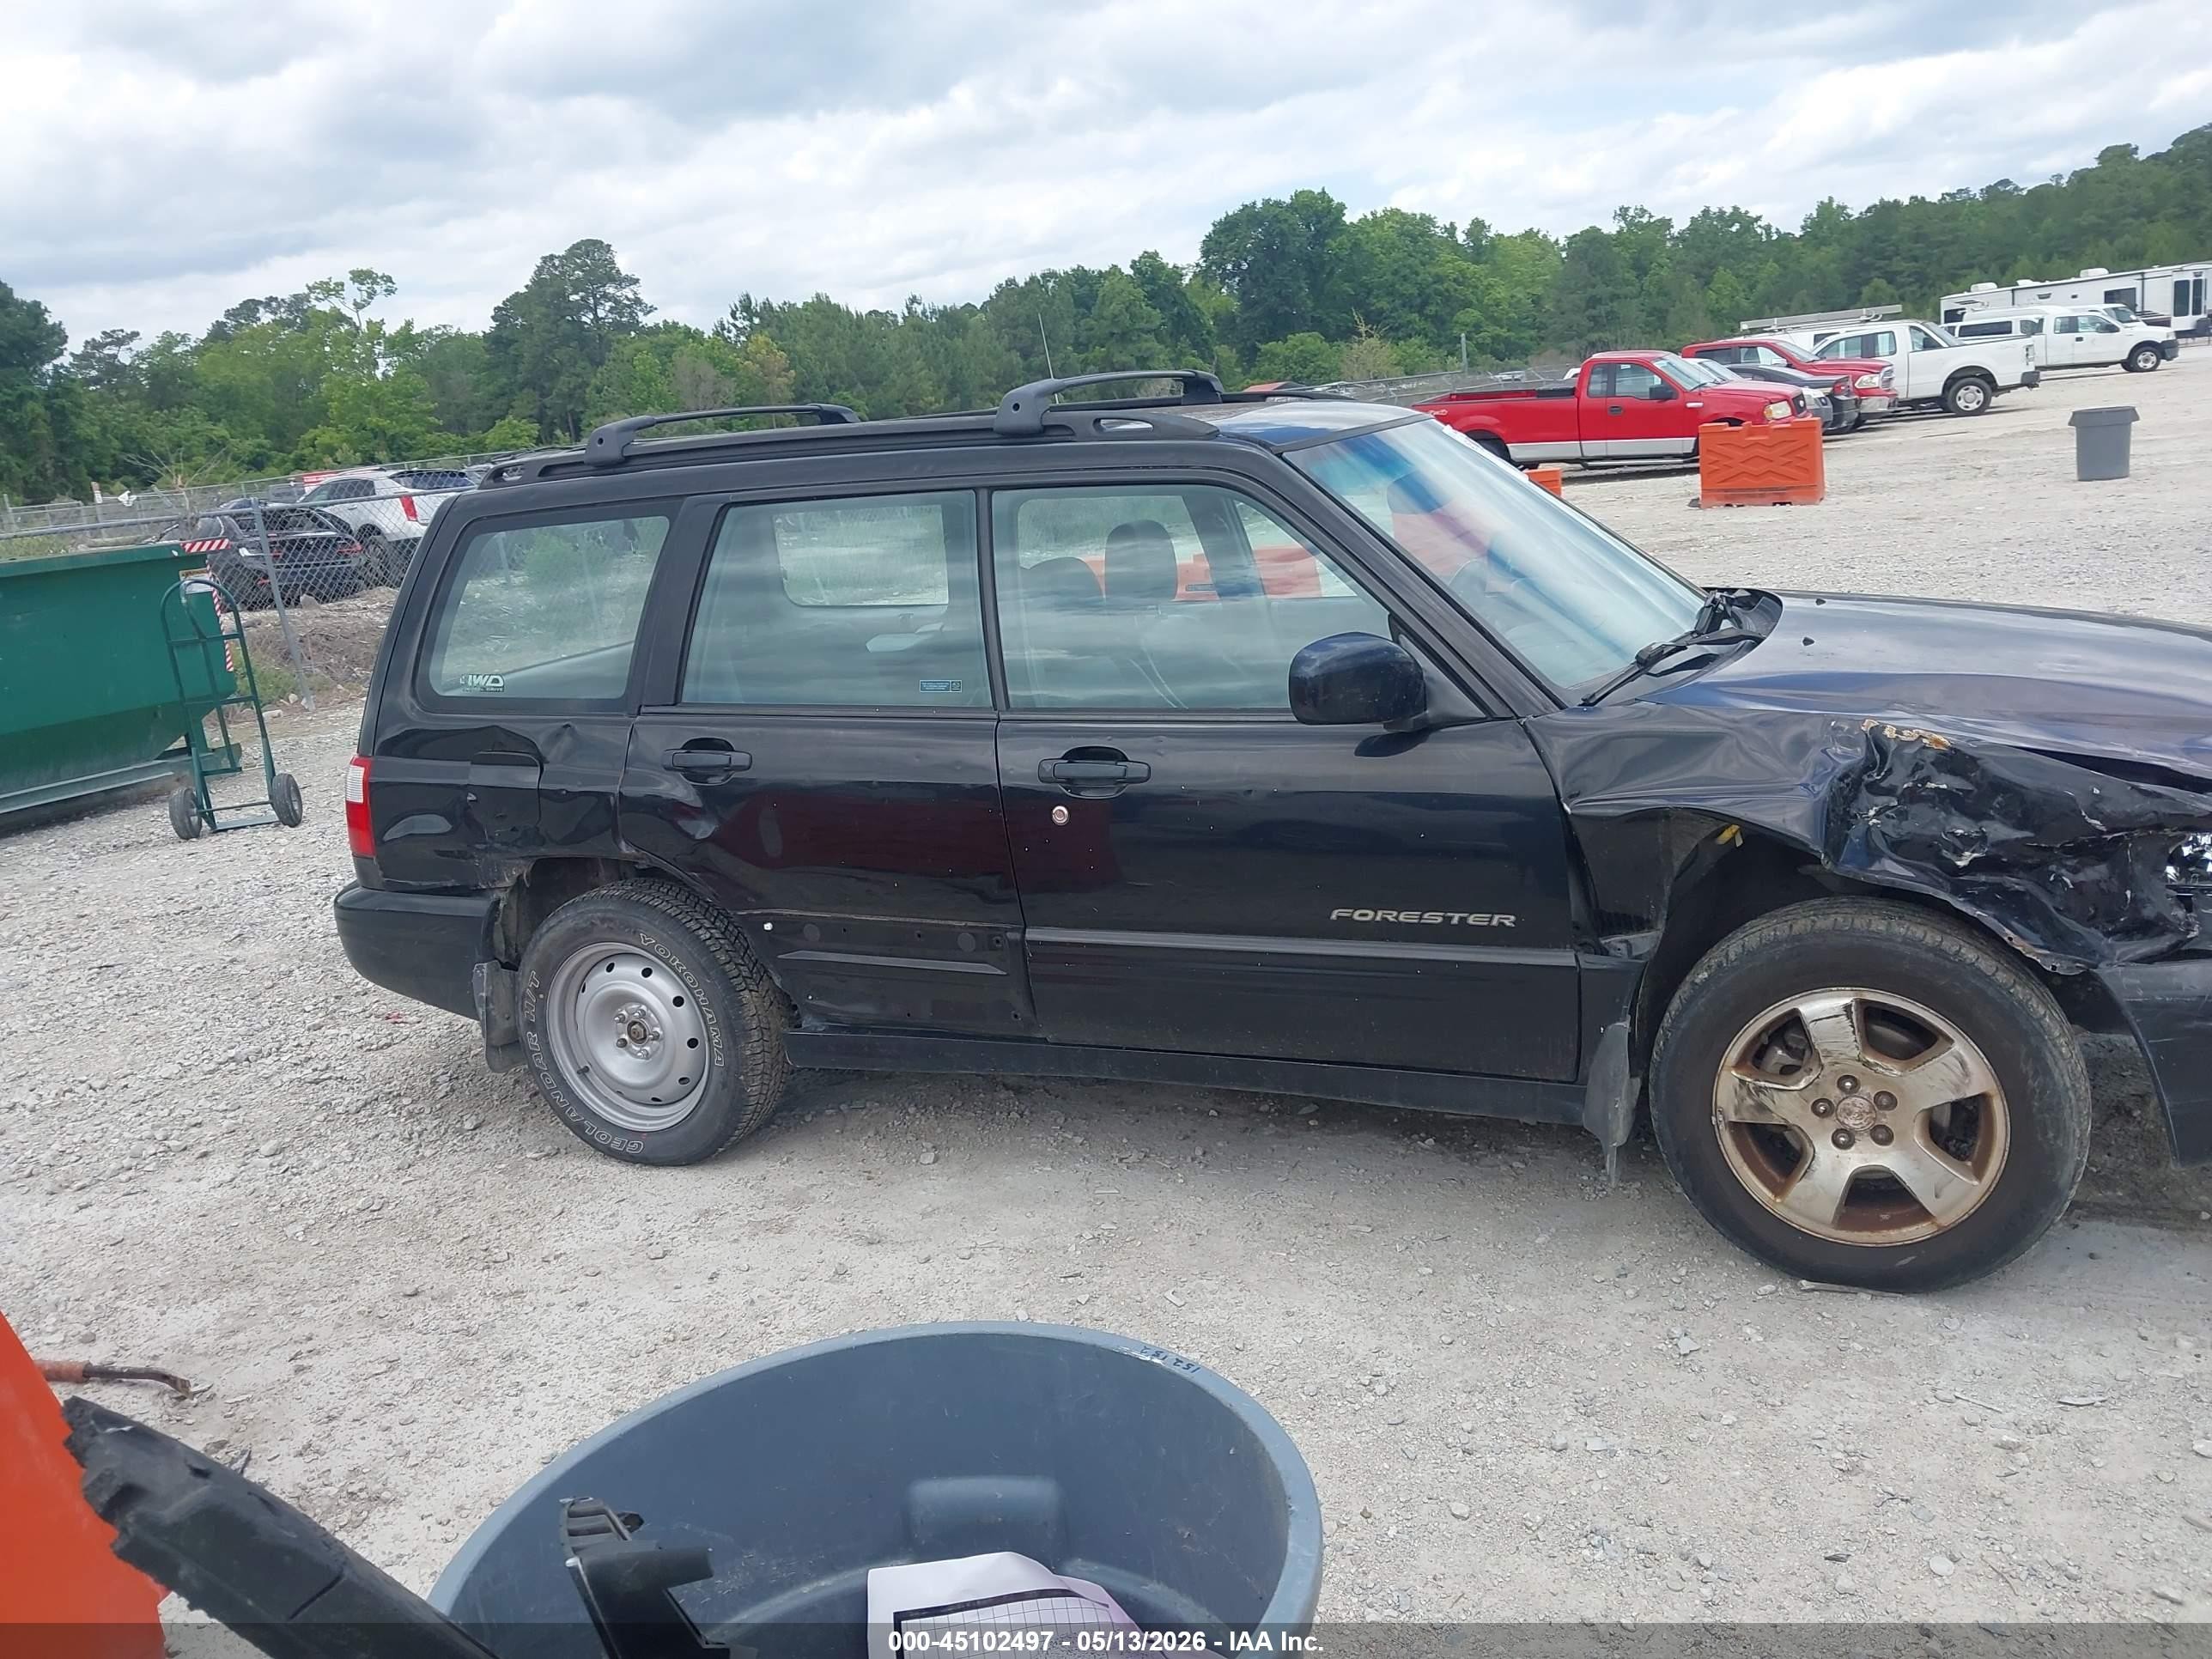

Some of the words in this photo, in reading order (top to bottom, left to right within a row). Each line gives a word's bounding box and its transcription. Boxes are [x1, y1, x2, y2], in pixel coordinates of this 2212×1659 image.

[1329, 908, 1516, 927] FORESTER
[523, 970, 540, 1023] H/T
[639, 933, 726, 1066] YOKOHAMA
[524, 1031, 646, 1154] GEOLANDAR
